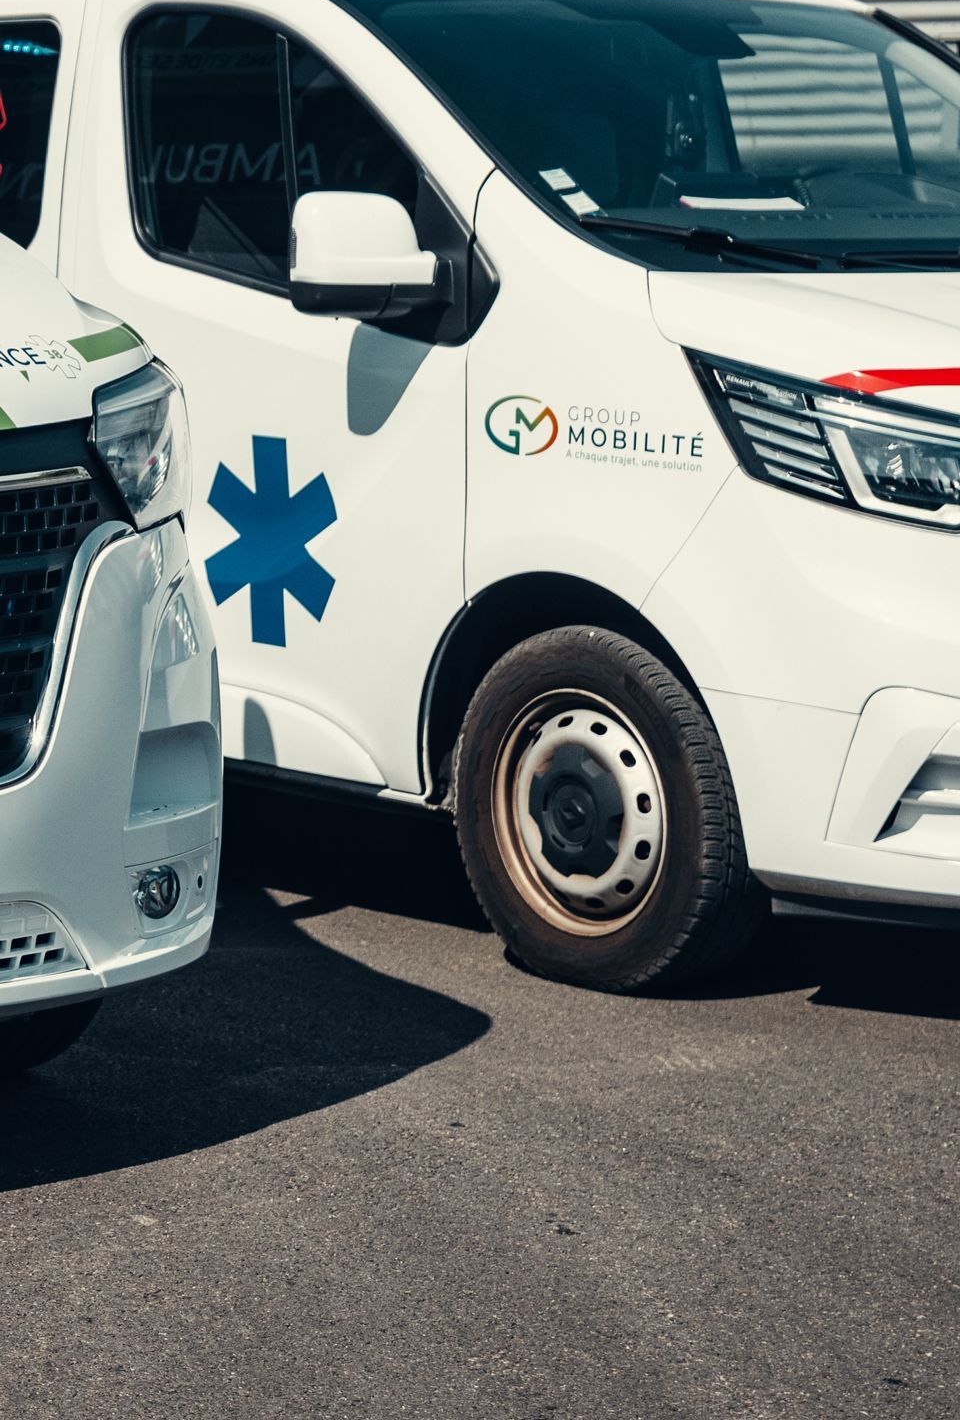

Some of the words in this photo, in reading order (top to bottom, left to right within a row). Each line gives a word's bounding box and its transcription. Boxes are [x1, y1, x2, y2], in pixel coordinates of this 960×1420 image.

[44, 349, 63, 359] 38
[726, 373, 754, 388] RENAULT
[567, 405, 641, 426] GROUP
[568, 425, 705, 458] MOBILITÉ
[574, 449, 609, 464] chaque
[610, 453, 639, 468] trajet,
[641, 458, 660, 469] une
[662, 457, 703, 473] solution
